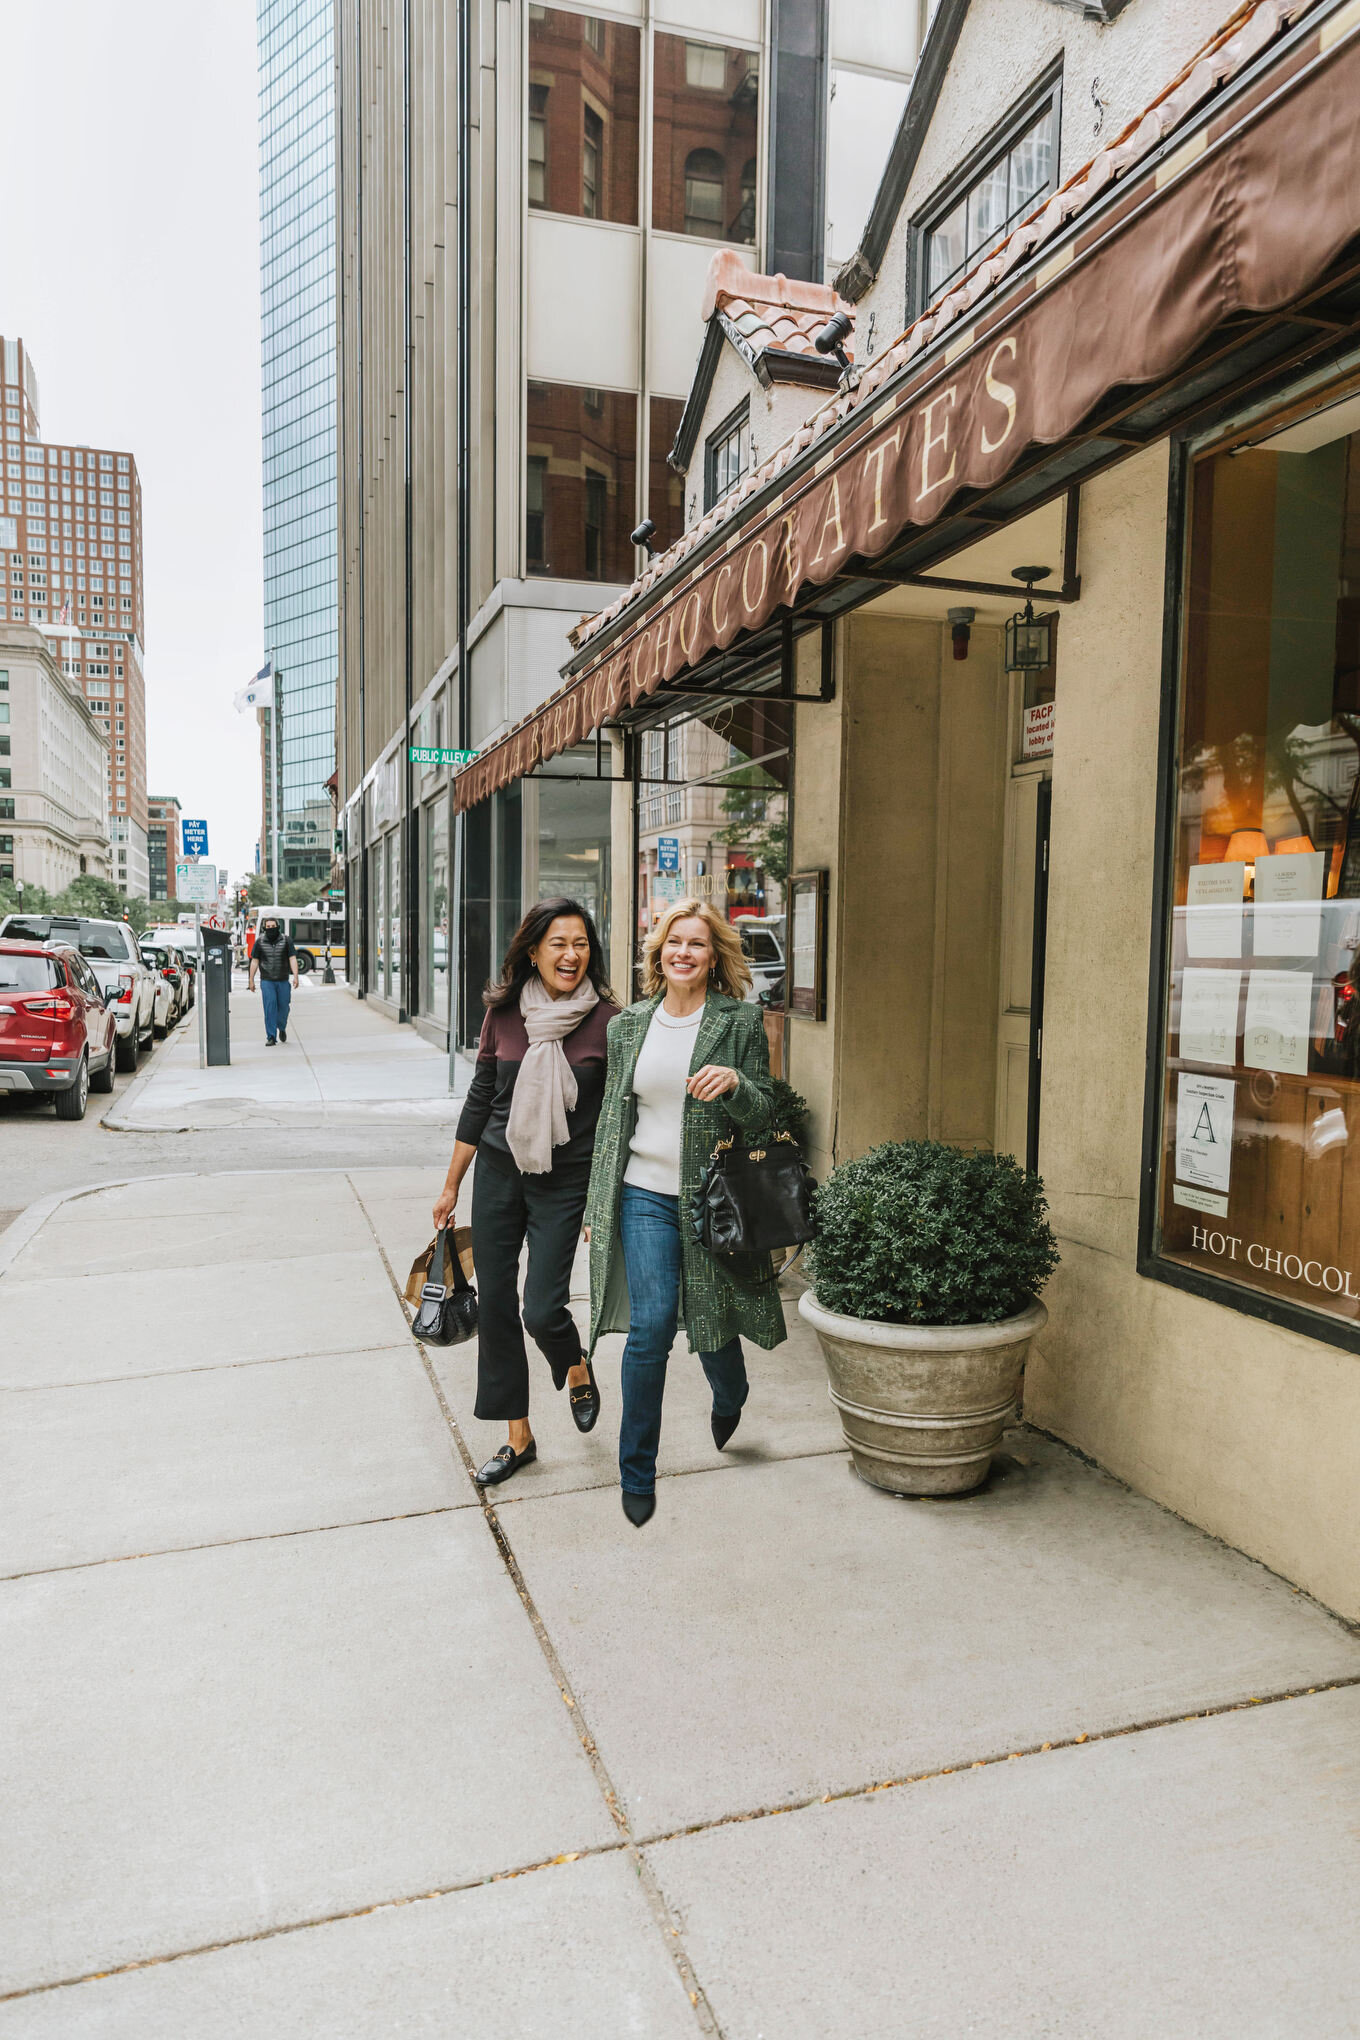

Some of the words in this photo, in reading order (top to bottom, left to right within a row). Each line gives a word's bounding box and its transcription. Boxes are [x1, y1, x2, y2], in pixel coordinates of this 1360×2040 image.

[530, 656, 621, 763] BURDICK
[634, 337, 1018, 688] CHOCOLATES
[1030, 705, 1053, 722] FACP
[1026, 721, 1050, 734] located
[1028, 735, 1046, 746] lobby
[1046, 732, 1054, 741] of
[412, 749, 439, 763] PUBLIC
[441, 751, 465, 764] ALLEY
[184, 828, 206, 836] METER
[187, 835, 204, 843] HERE
[1190, 1101, 1218, 1144] A
[1191, 1225, 1242, 1260] HOT
[1247, 1243, 1360, 1300] CHOCOL
